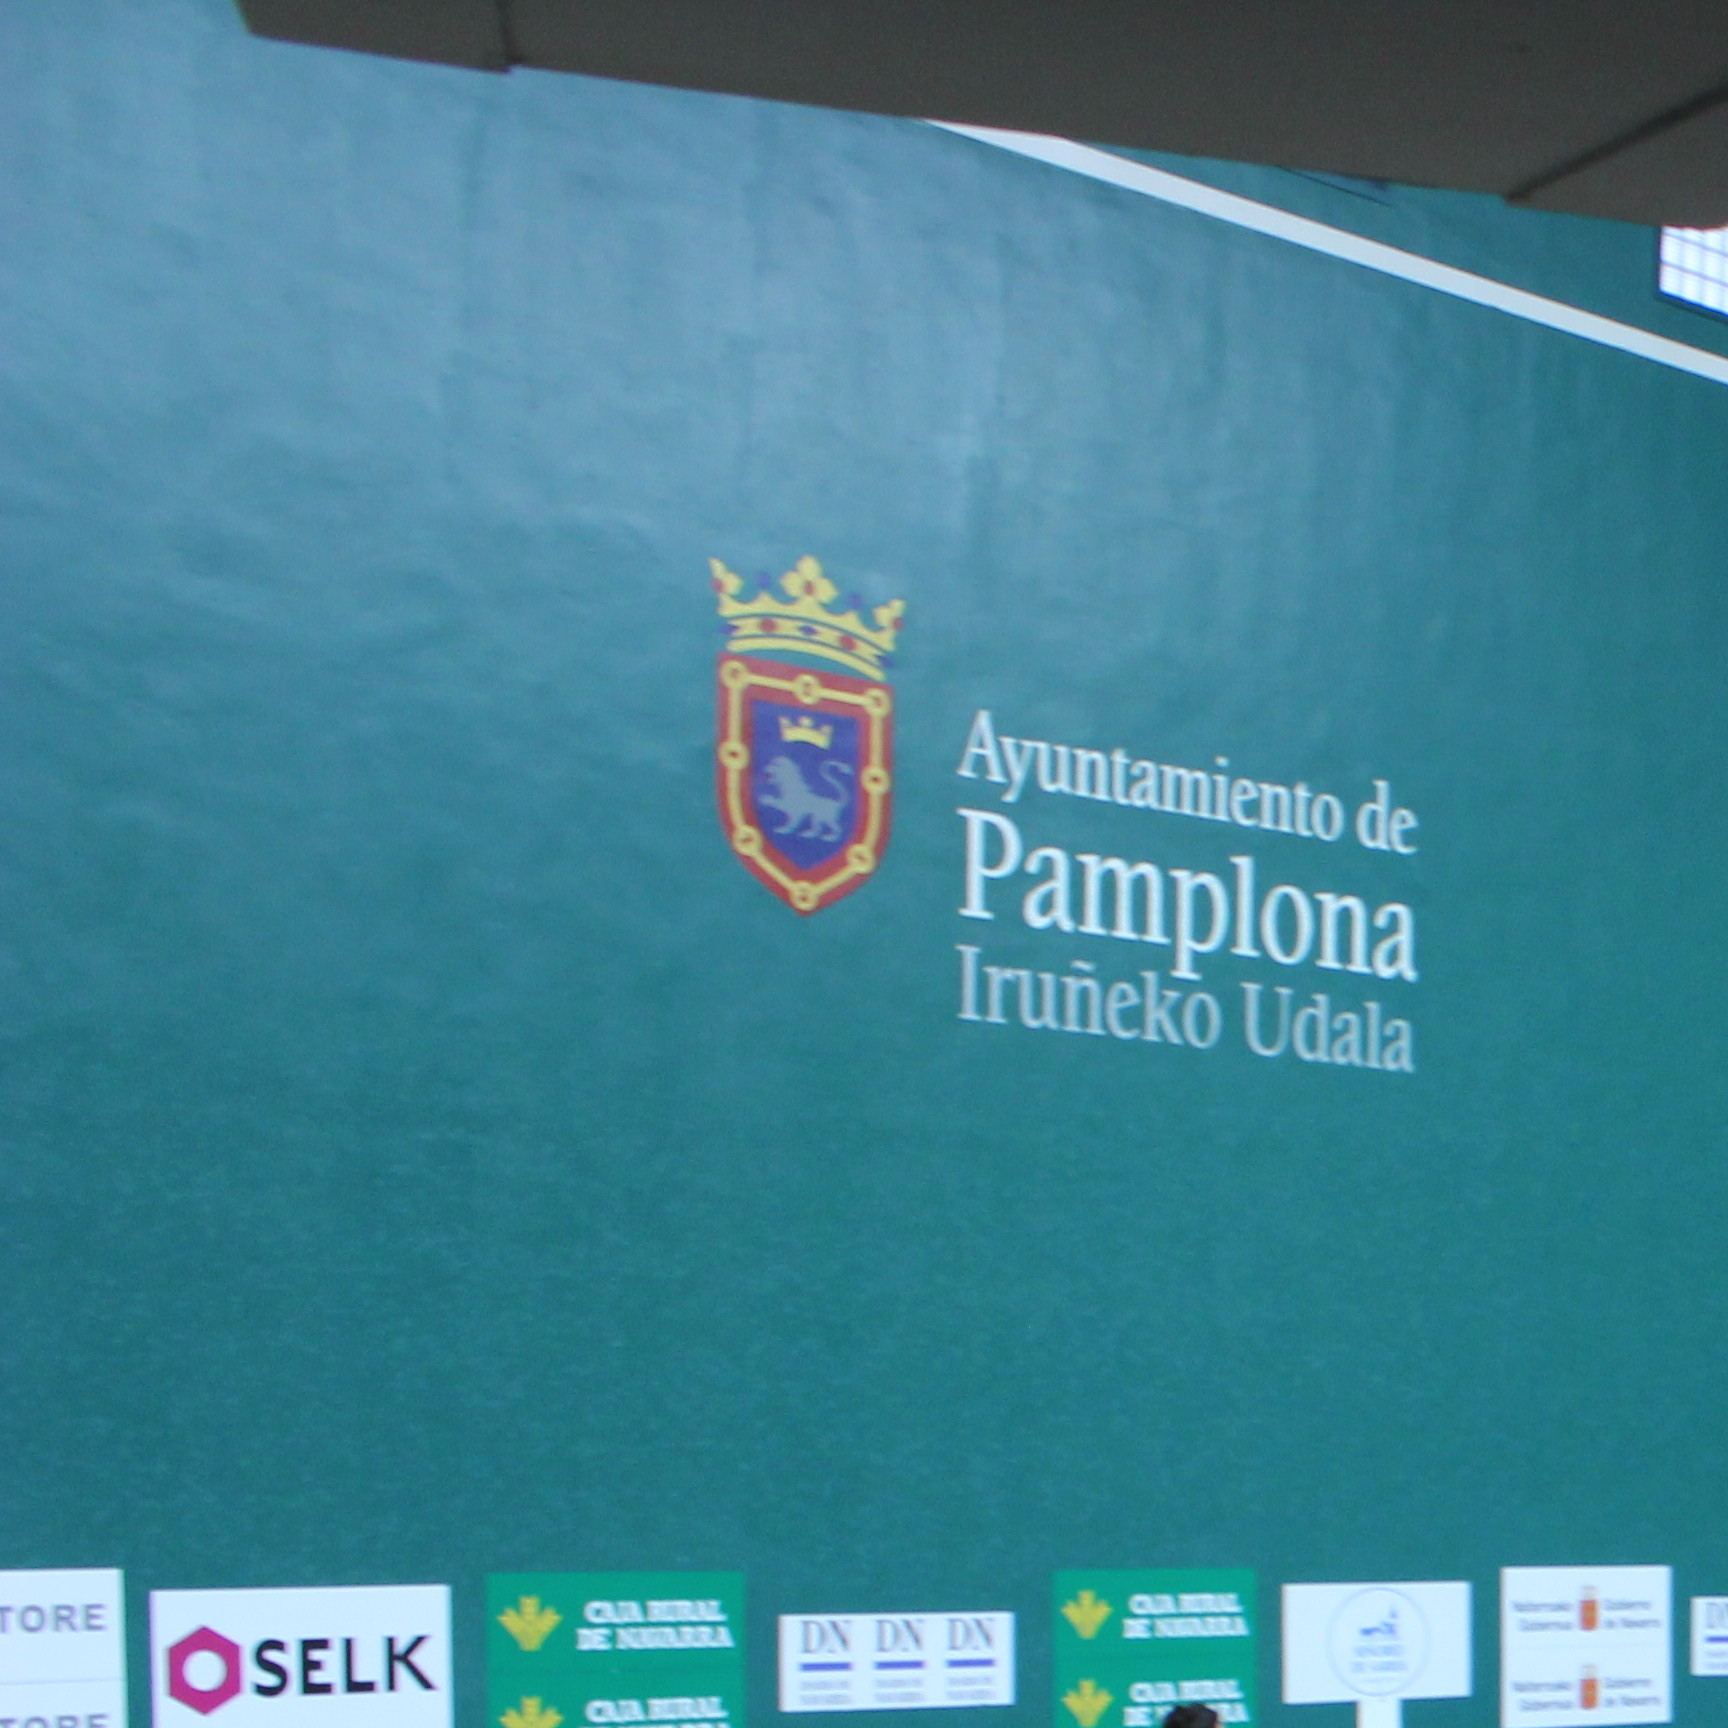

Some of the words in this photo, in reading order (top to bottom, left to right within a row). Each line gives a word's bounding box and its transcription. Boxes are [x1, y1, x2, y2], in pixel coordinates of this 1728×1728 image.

[956, 709, 1344, 843] Ayuntamiento
[1356, 780, 1418, 854] de
[957, 807, 1418, 983] Pamplona
[956, 943, 1223, 1050] Iruñeko
[1240, 981, 1415, 1073] Udala
[583, 1599, 644, 1624] CAJA
[646, 1599, 728, 1622] RURAL
[799, 1619, 852, 1654] DN
[874, 1618, 926, 1653] DN
[947, 1616, 996, 1651] DN
[576, 1627, 612, 1650] DE
[615, 1625, 735, 1650] NAVARRA
[251, 1635, 439, 1698] SELK
[585, 1699, 645, 1723] CAJA
[646, 1696, 729, 1722] RURAL
